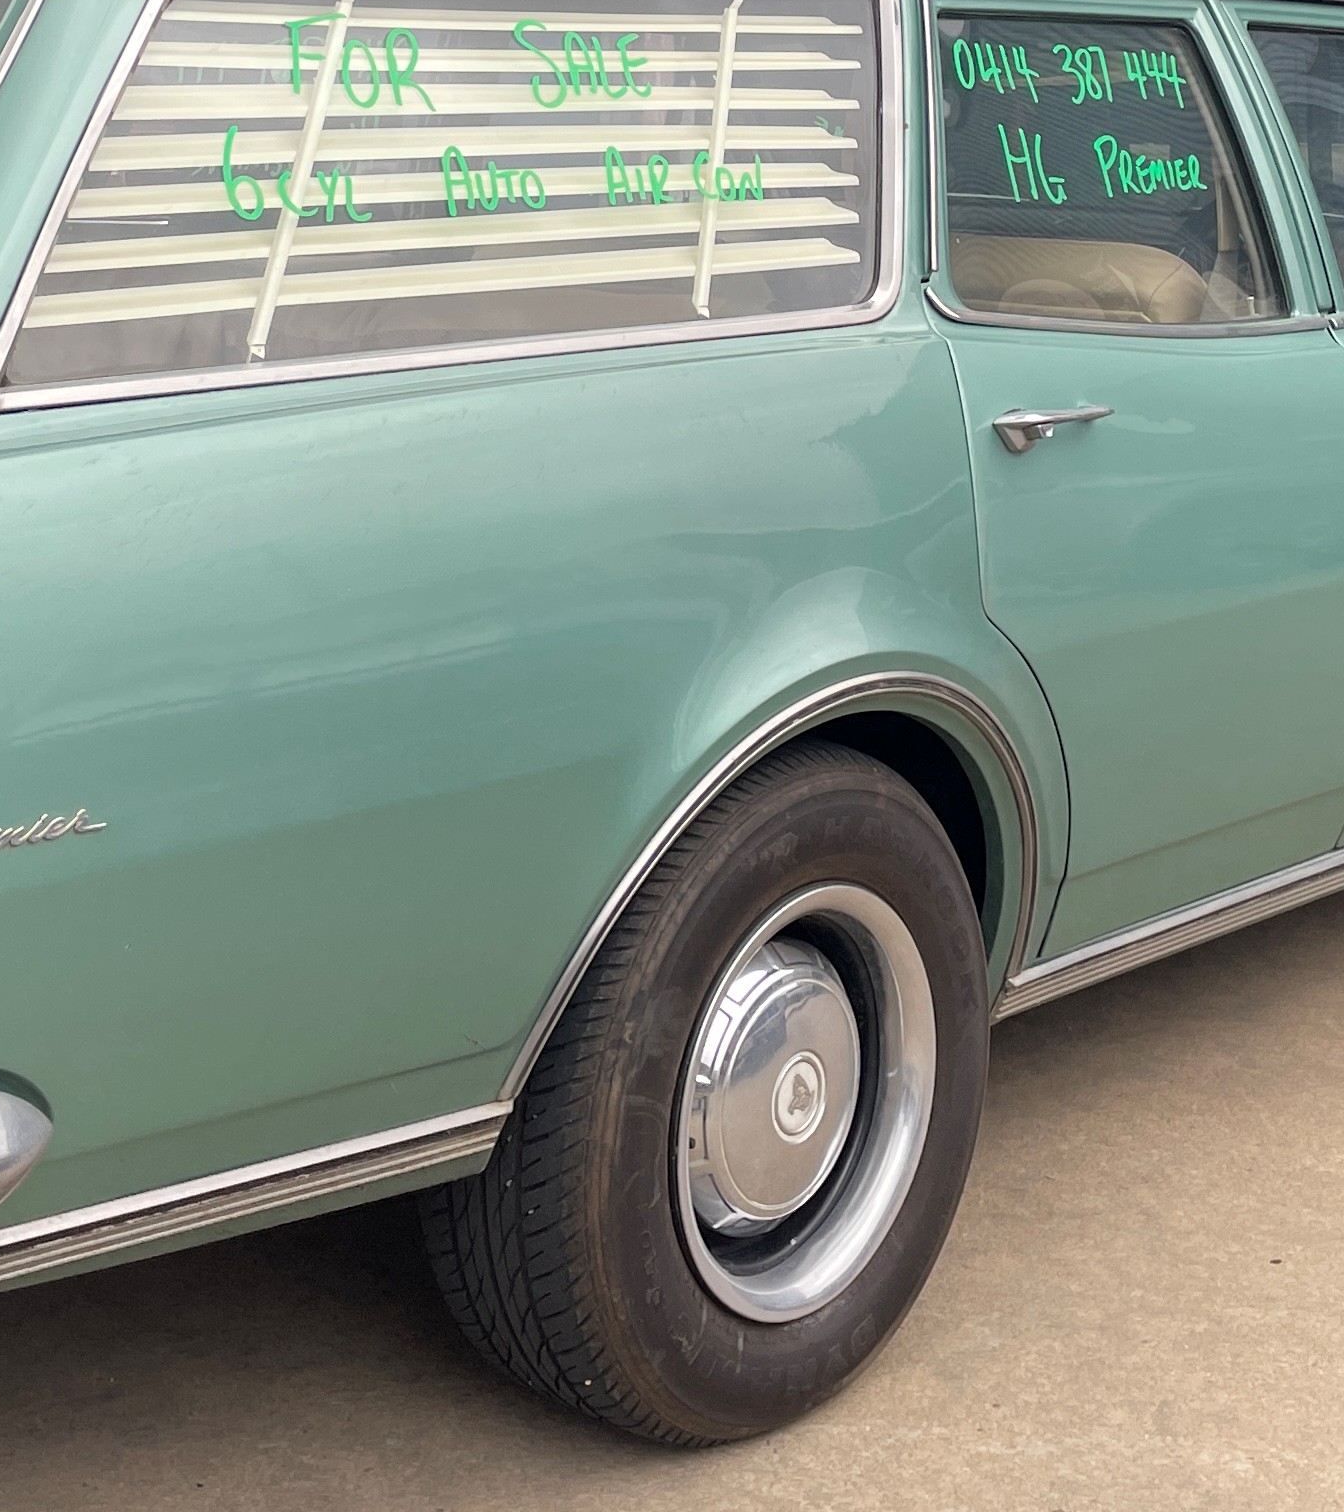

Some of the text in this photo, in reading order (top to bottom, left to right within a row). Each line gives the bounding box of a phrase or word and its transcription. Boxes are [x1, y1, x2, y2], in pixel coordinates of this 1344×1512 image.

[284, 12, 653, 112] FOR SALE
[953, 38, 1187, 110] 0414 387 444
[441, 145, 547, 218] AUTO
[605, 145, 670, 207] AIR
[692, 150, 766, 203] CON
[997, 123, 1209, 205] HG PREMIER
